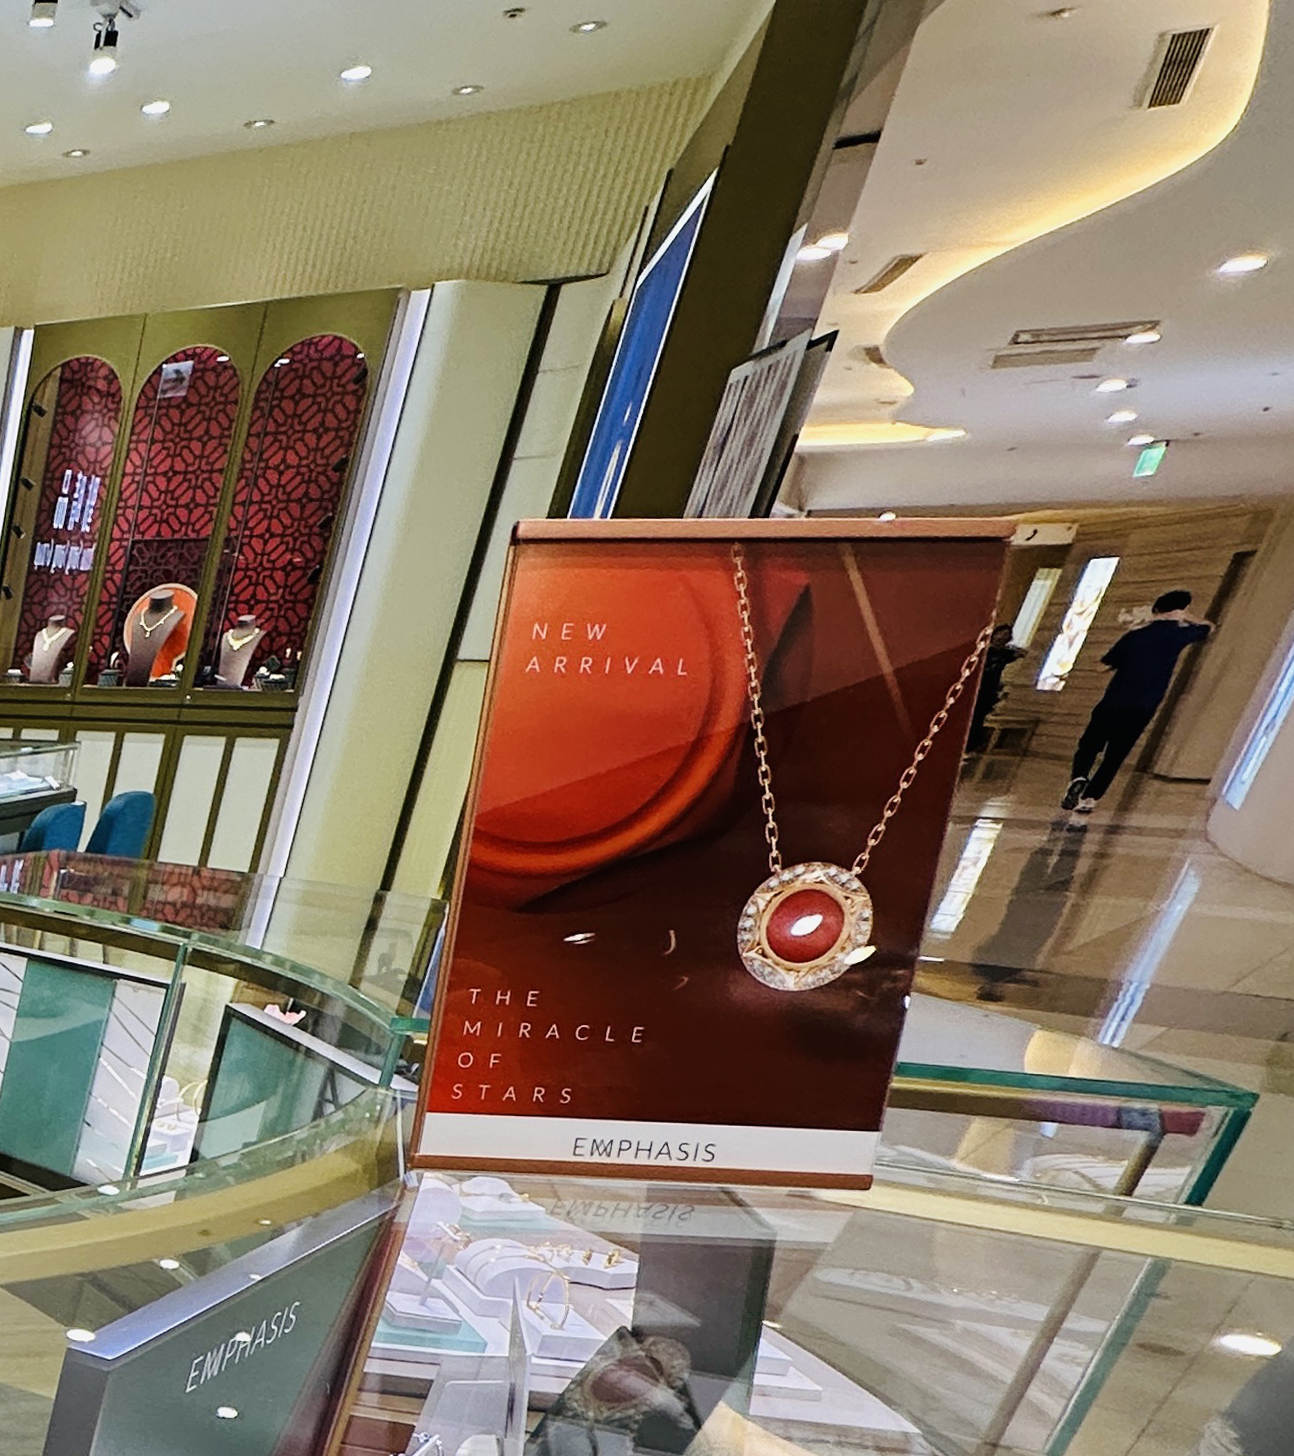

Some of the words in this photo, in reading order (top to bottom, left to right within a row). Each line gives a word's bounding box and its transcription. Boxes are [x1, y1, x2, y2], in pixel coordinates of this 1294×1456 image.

[531, 622, 607, 641] NEW
[525, 655, 689, 677] ARRIVAL
[469, 988, 540, 1008] THE
[463, 1020, 645, 1044] MIRACLE
[457, 1052, 502, 1070] OF
[451, 1083, 573, 1105] STARS
[572, 1136, 717, 1163] EMPHASIS
[185, 1301, 301, 1394] EMPHASIS
